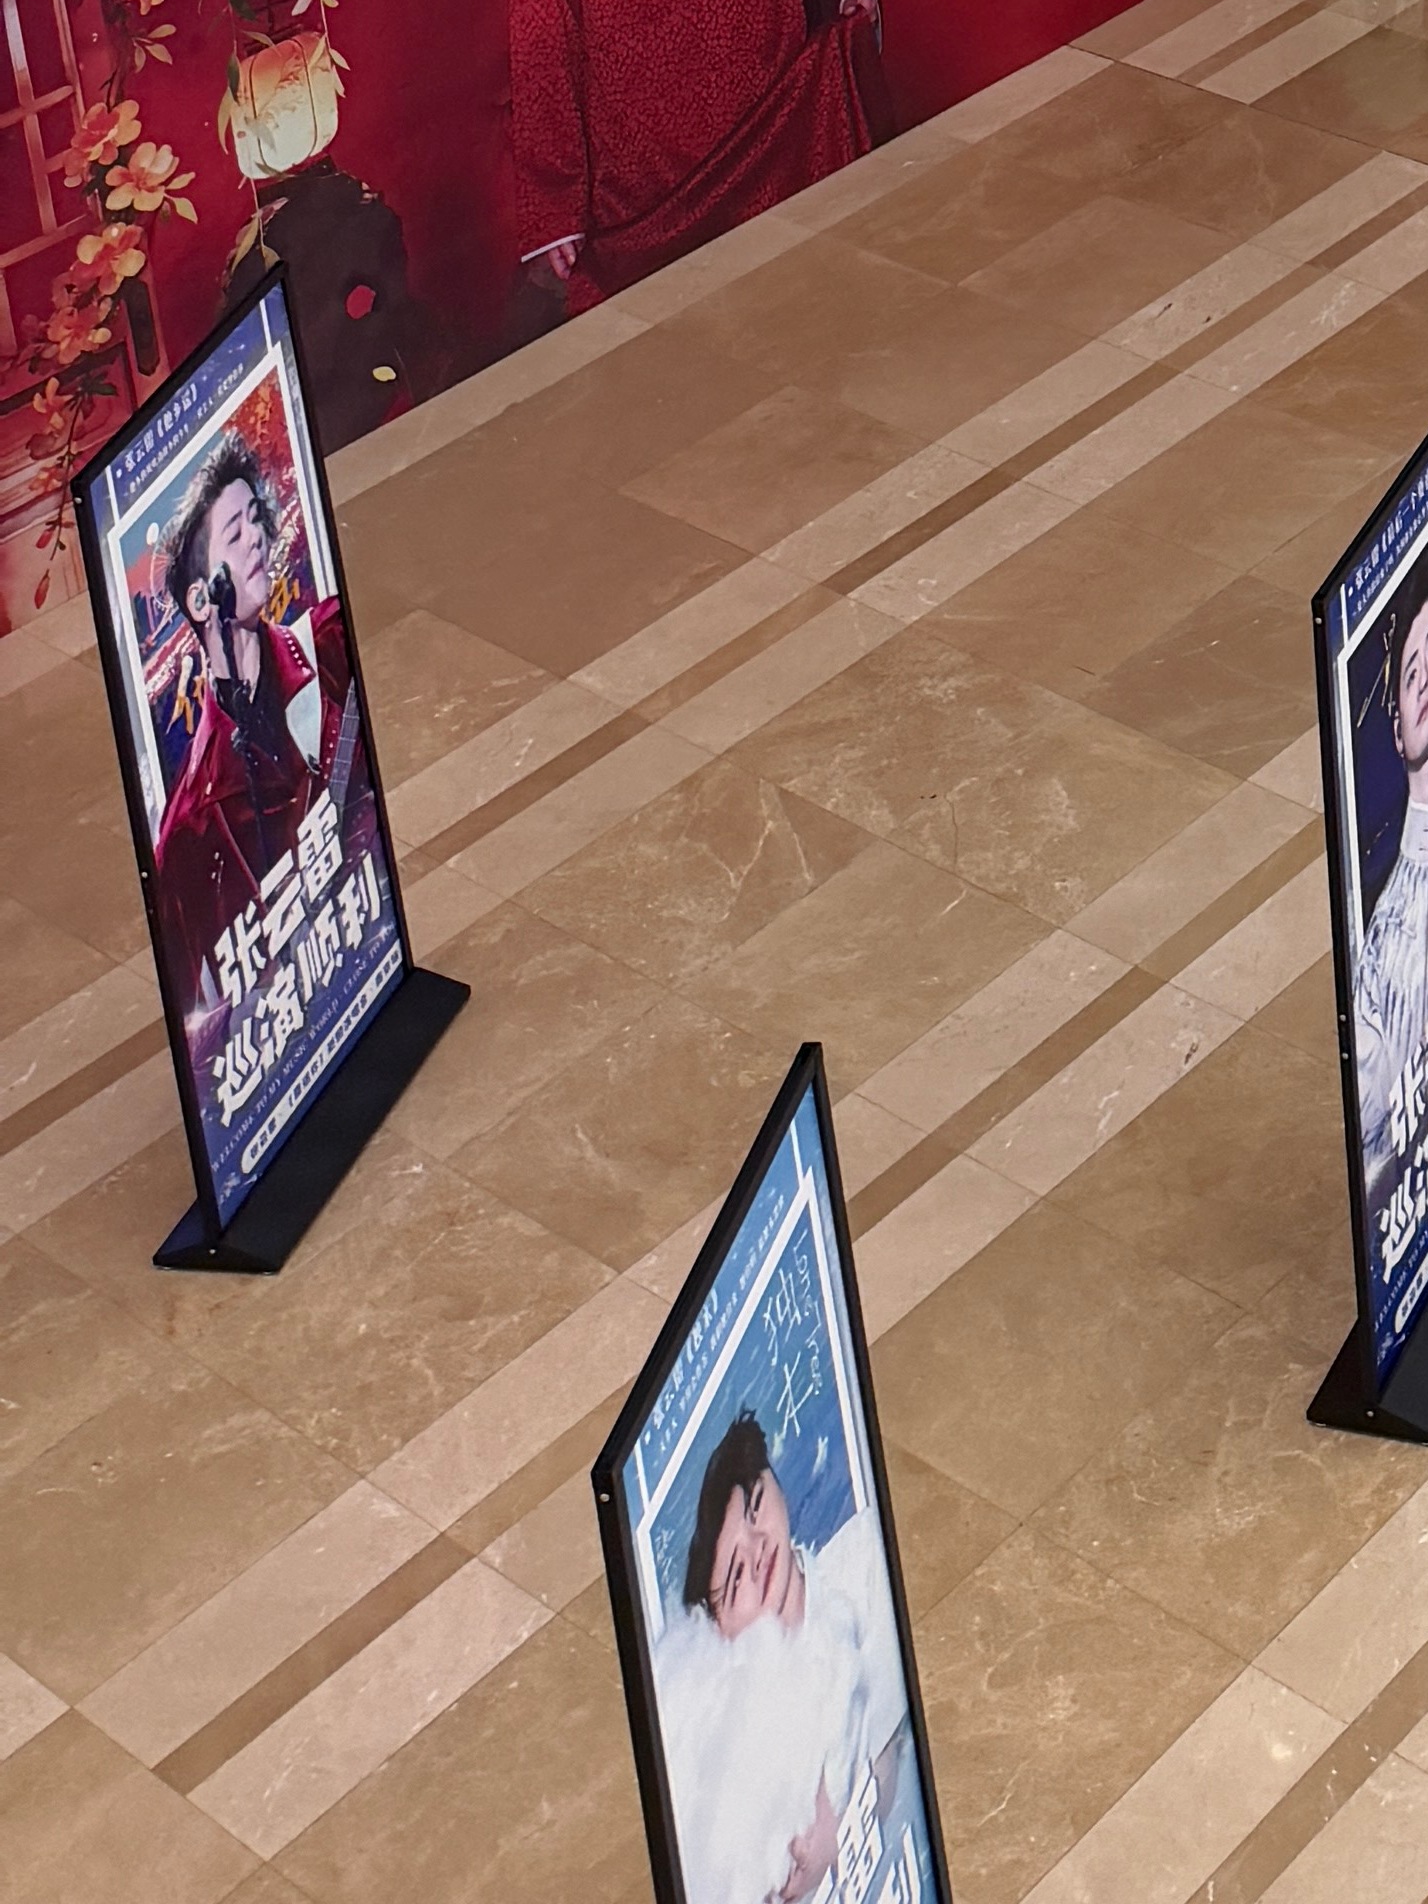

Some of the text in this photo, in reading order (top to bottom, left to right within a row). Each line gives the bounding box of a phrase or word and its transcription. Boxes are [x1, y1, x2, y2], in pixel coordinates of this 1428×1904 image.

[212, 851, 380, 1128] 巡演顺利
[214, 788, 342, 1008] 张云雷
